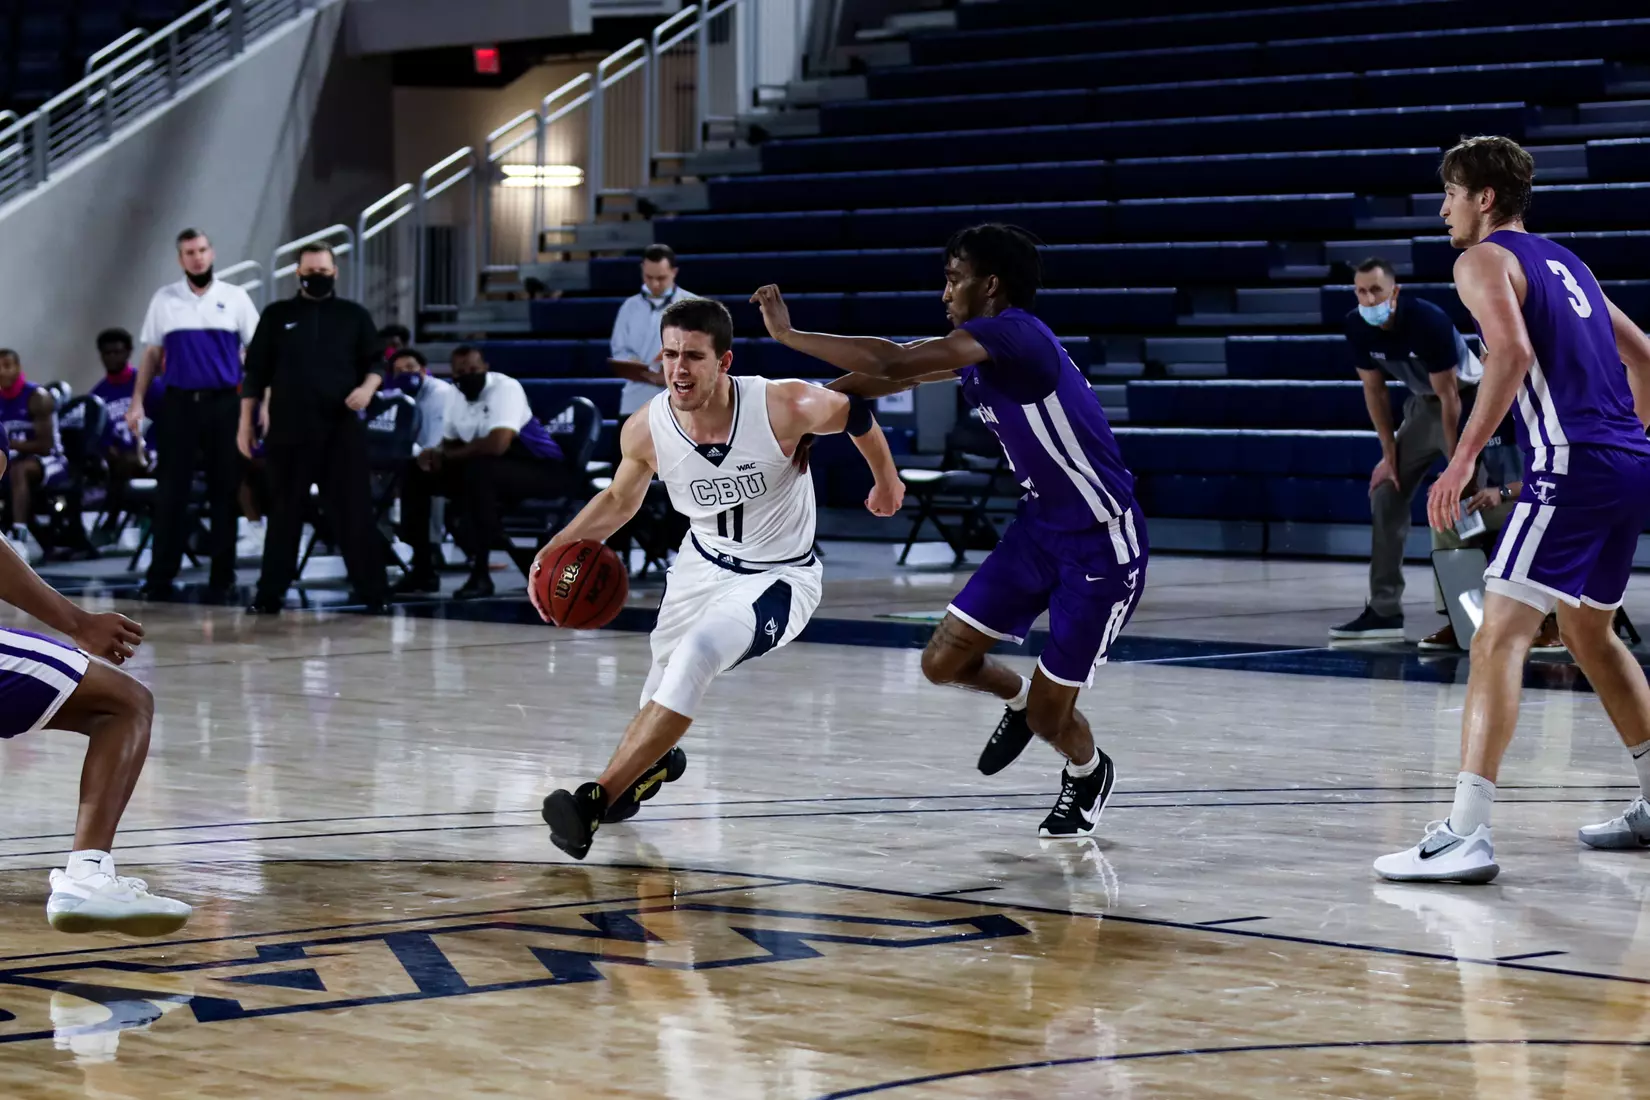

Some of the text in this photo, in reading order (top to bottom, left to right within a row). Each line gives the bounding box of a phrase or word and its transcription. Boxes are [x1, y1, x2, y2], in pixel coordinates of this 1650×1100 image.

[1546, 259, 1592, 318] 3
[736, 462, 757, 472] WAC
[690, 472, 767, 506] CBU
[554, 547, 592, 600] Wilson
